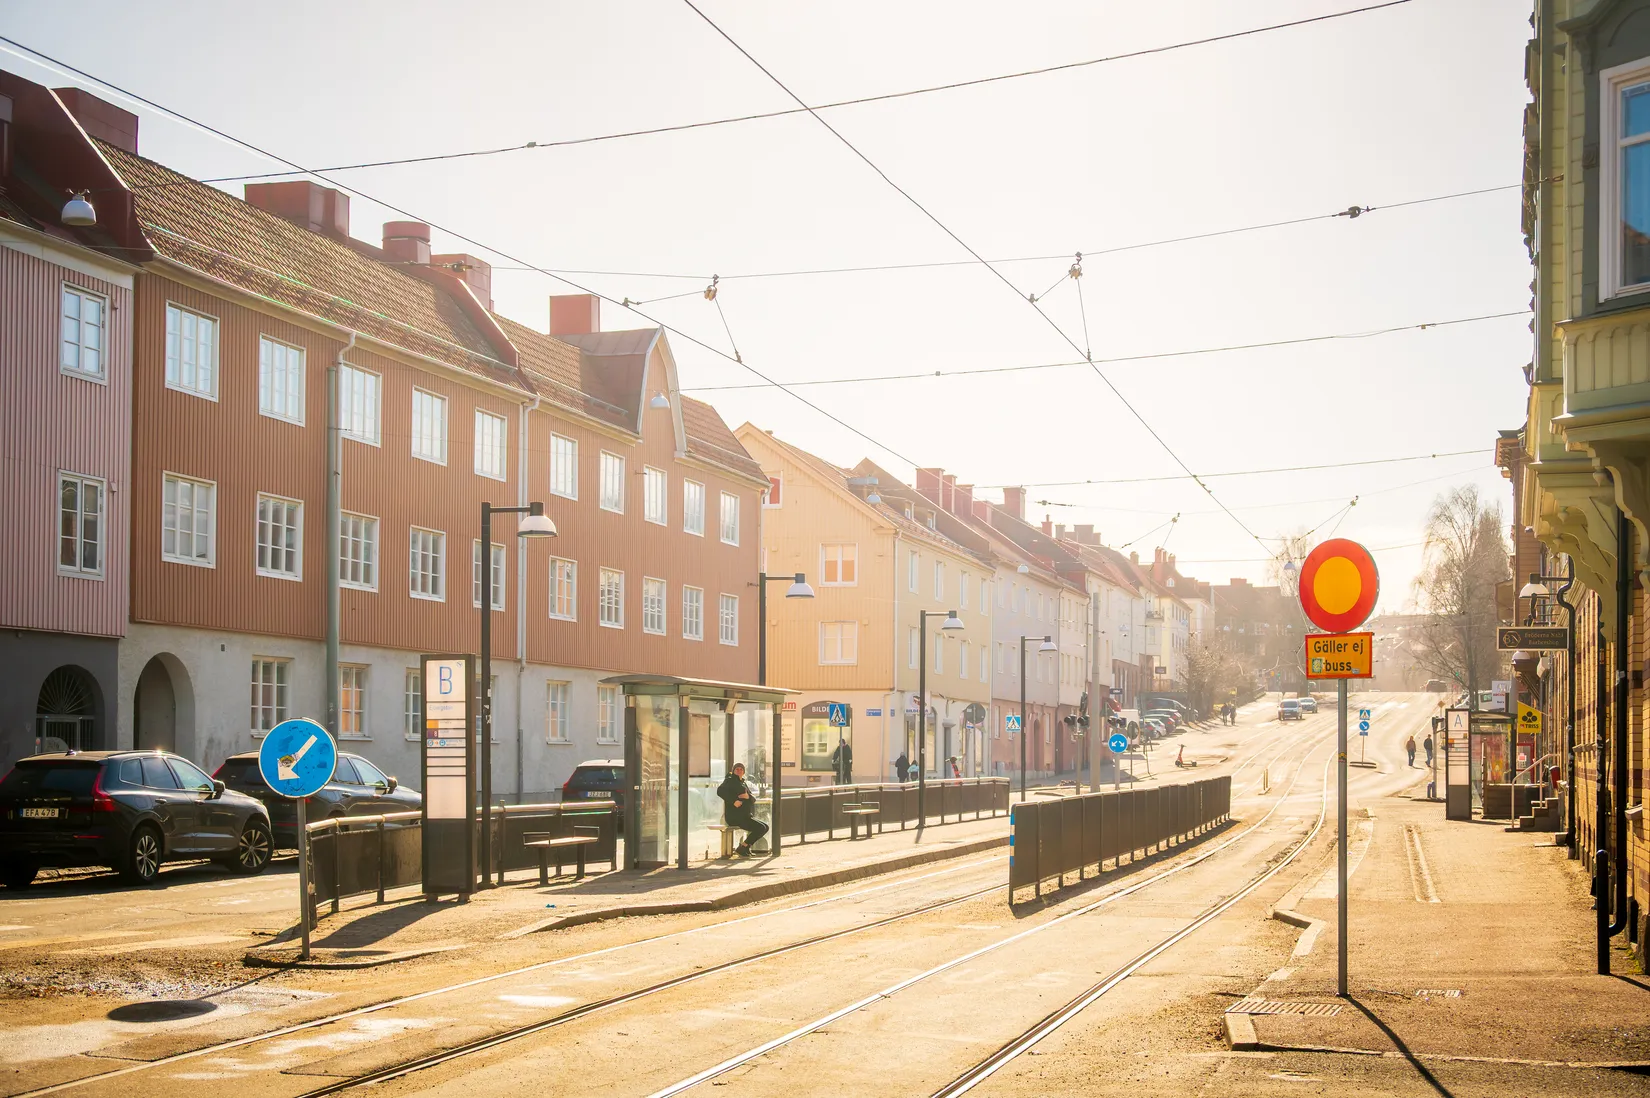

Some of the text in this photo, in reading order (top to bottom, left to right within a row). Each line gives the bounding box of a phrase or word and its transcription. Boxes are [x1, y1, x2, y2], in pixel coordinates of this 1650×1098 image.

[1314, 639, 1364, 655] Gäller ej
[439, 666, 452, 694] B
[1454, 714, 1463, 728] A
